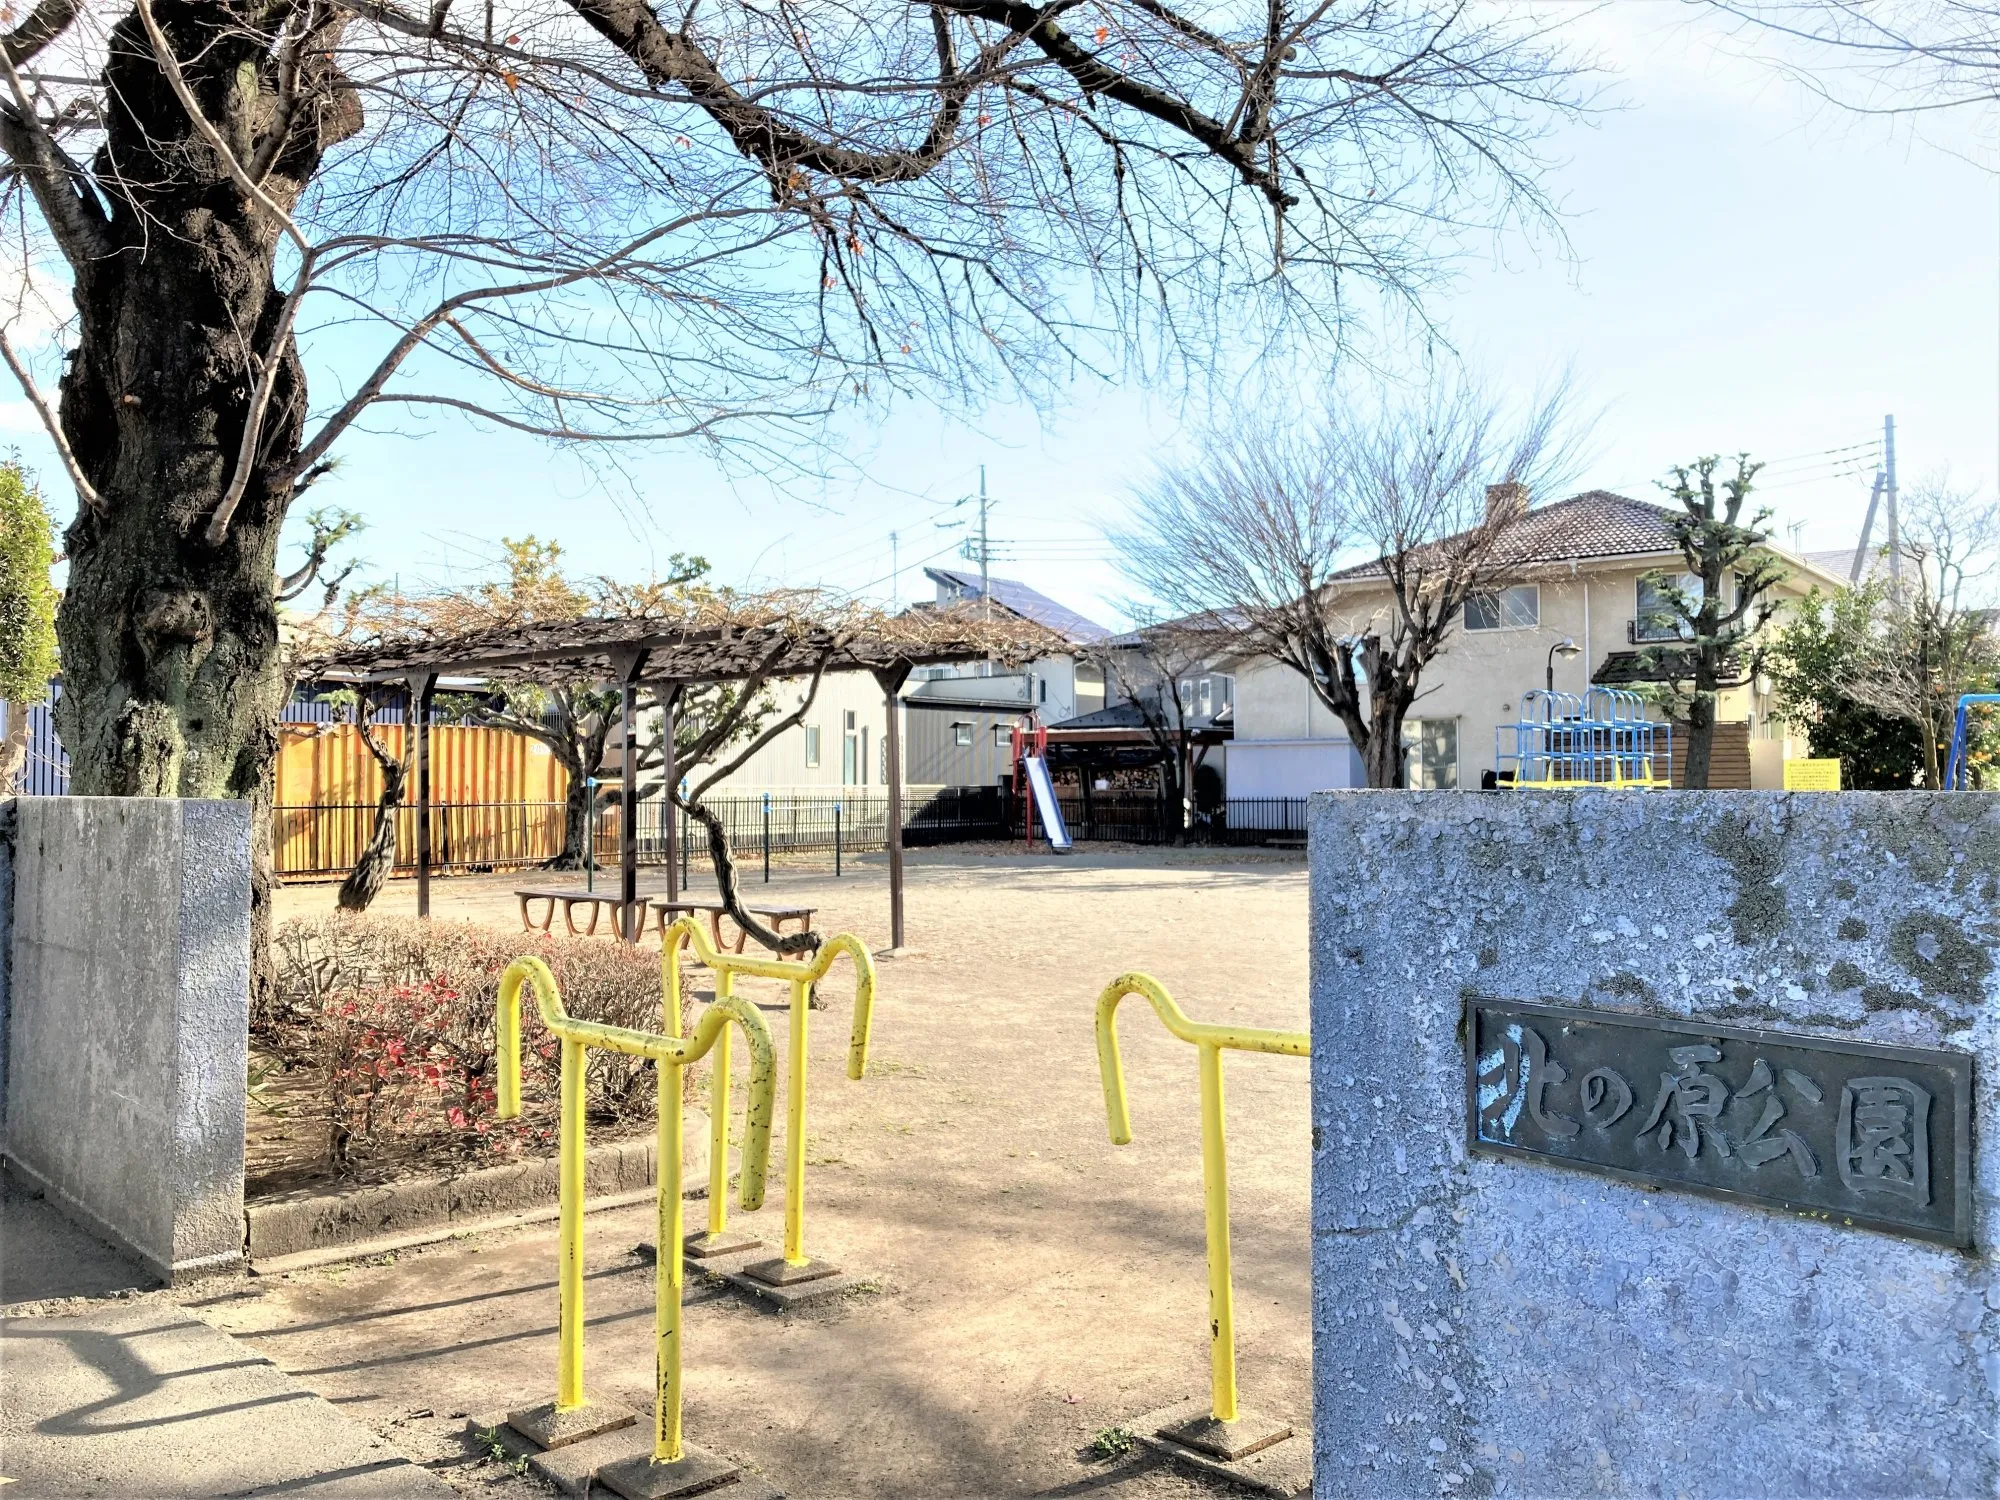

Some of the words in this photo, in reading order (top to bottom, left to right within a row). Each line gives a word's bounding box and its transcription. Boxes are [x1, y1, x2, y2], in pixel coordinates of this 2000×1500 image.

[1479, 1026, 1931, 1206] 北の原公園
